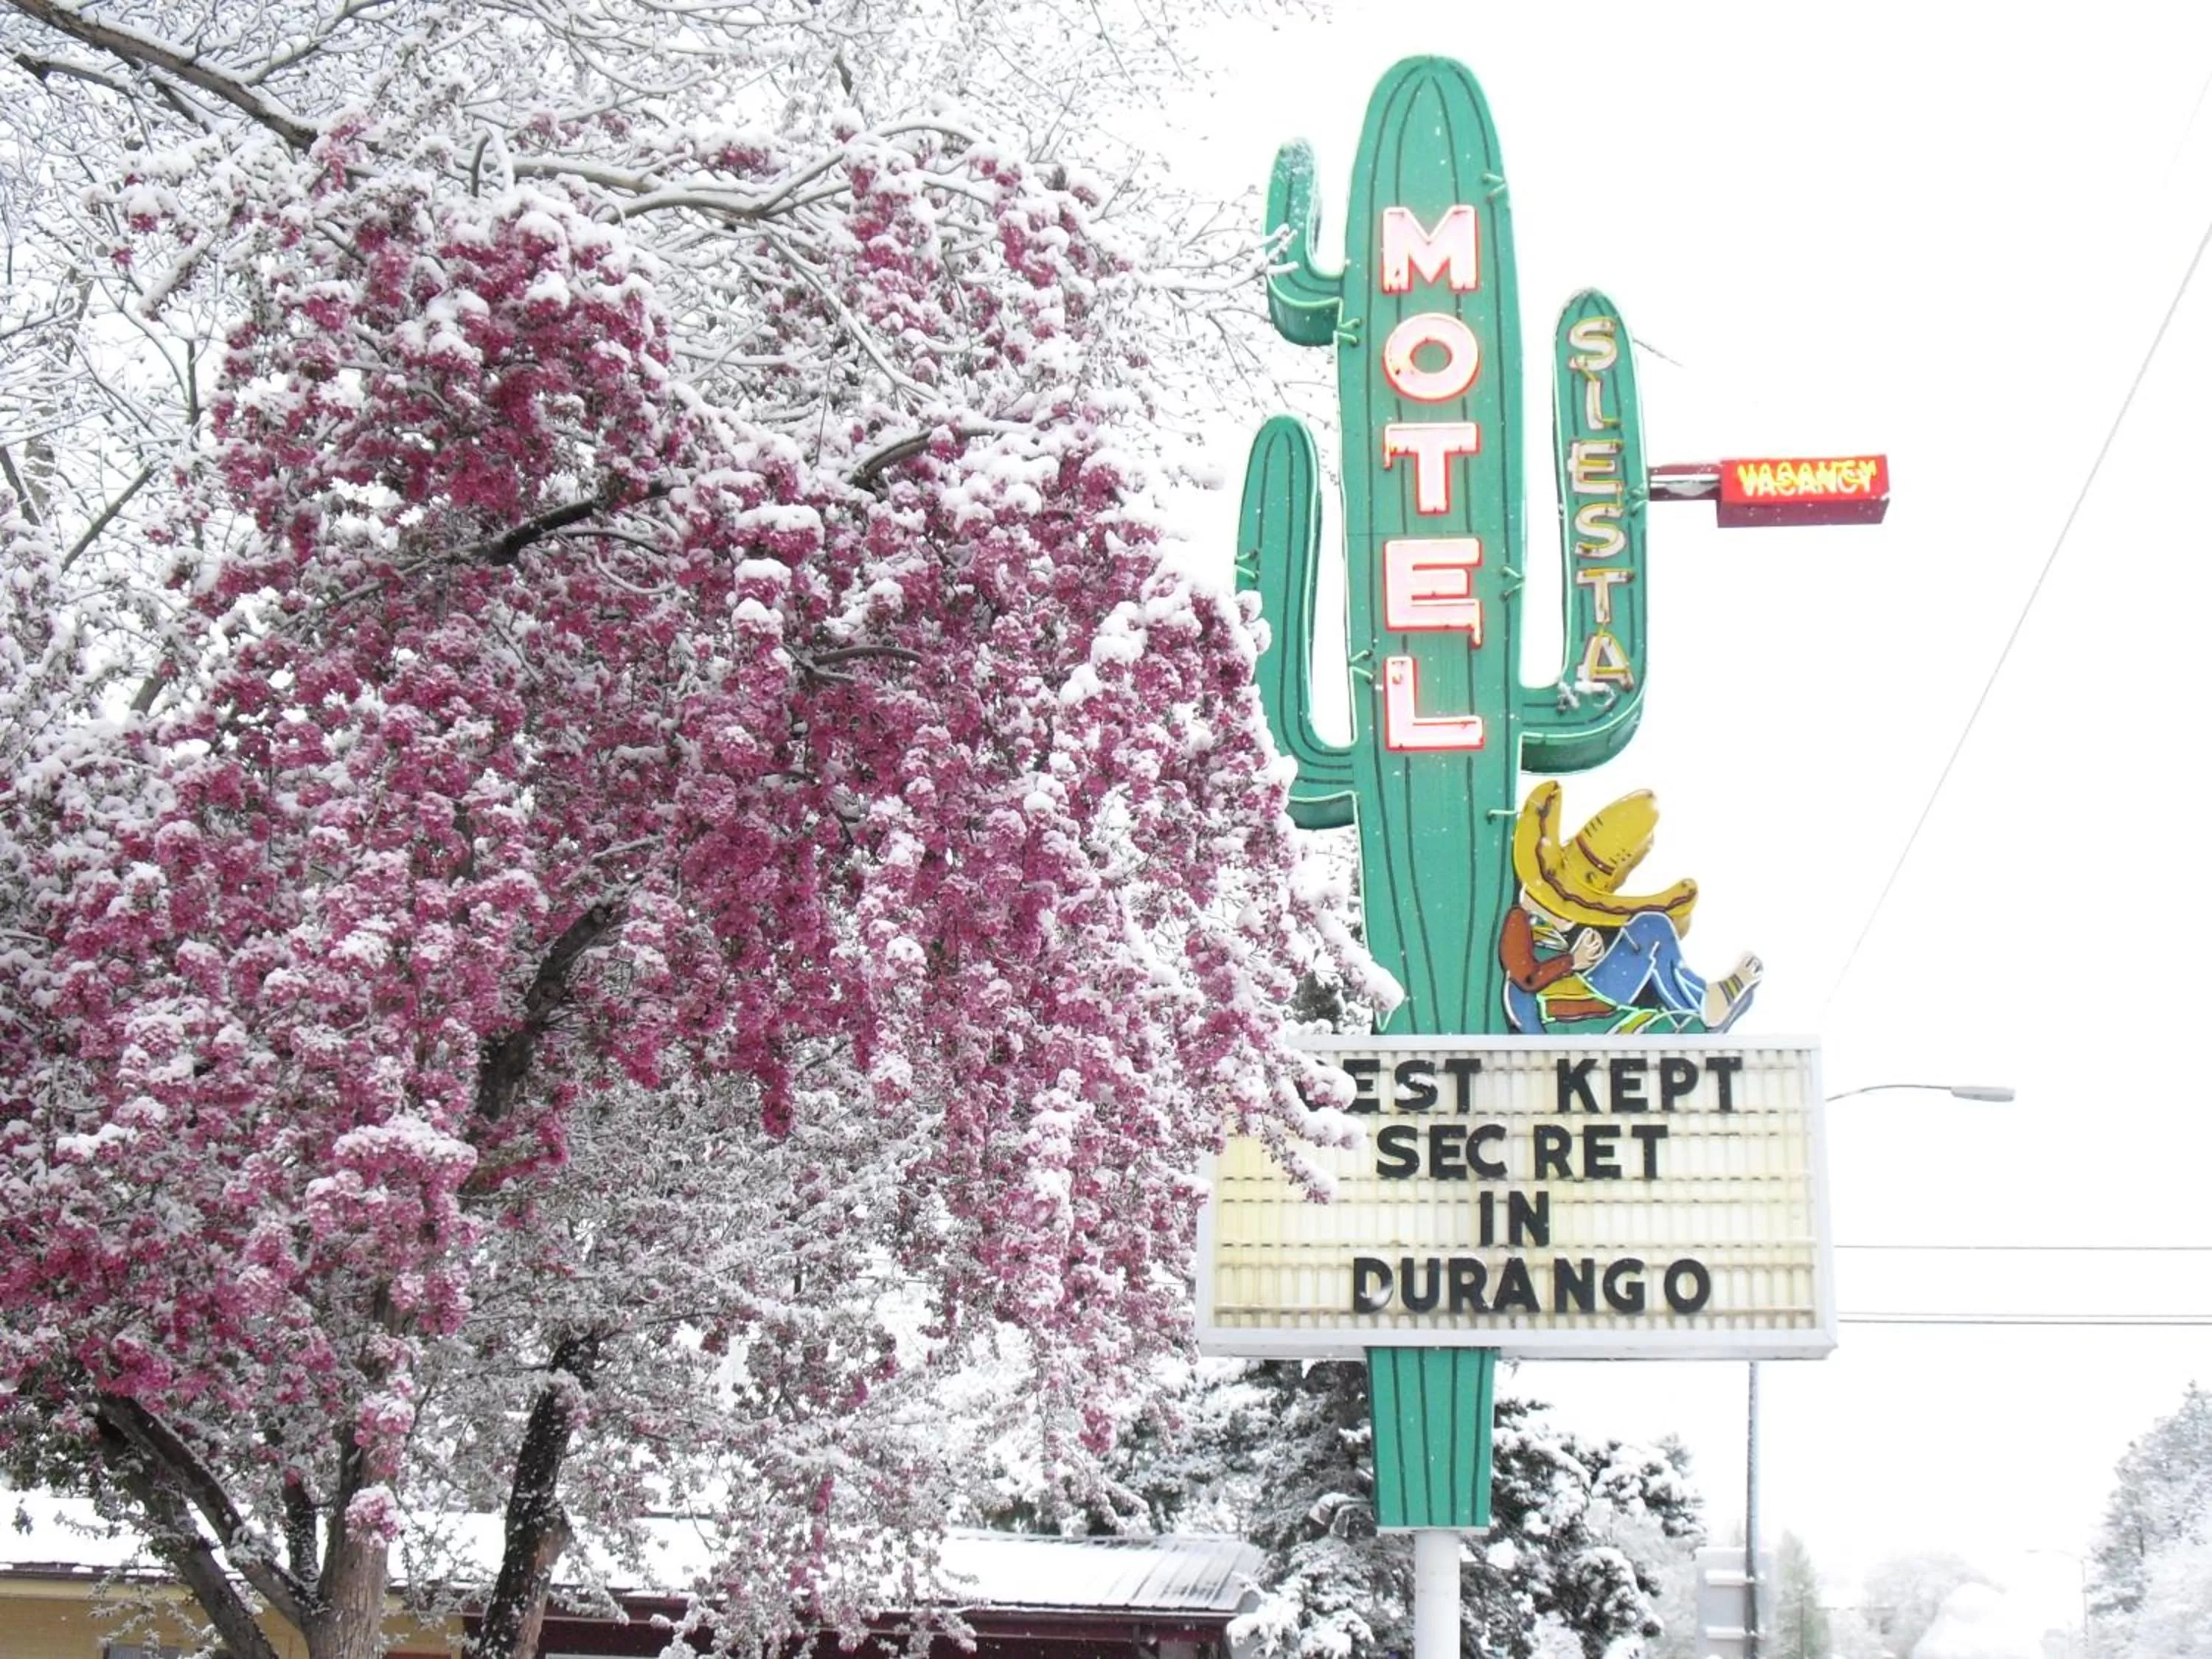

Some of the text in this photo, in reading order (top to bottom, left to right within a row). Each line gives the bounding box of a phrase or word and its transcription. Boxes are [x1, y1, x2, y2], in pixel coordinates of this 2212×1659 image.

[1382, 205, 1484, 750] MOTEL
[1568, 317, 1635, 692] SIESTA
[1737, 459, 1877, 496] VACANCY
[1293, 1057, 1742, 1113] EST KEPT
[1376, 1124, 1669, 1180] SECRET
[1479, 1190, 1551, 1247] IN
[1353, 1256, 1712, 1314] DURANGO
